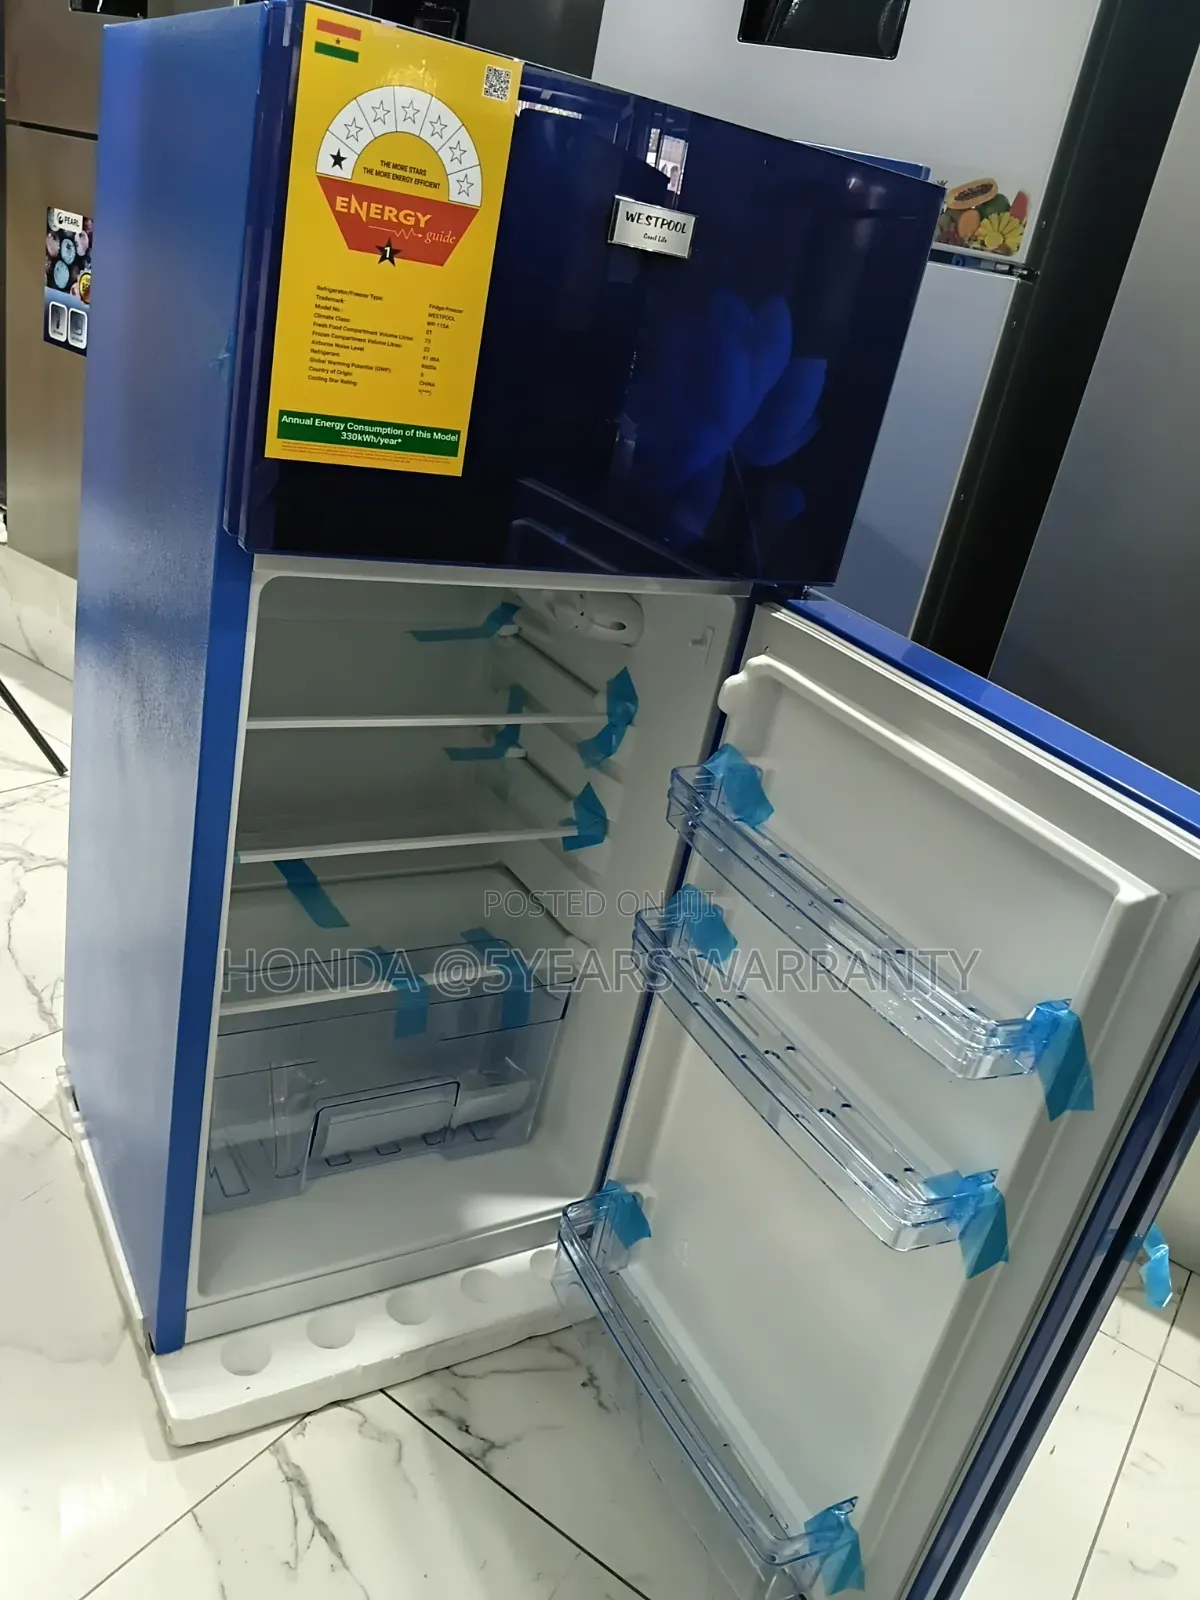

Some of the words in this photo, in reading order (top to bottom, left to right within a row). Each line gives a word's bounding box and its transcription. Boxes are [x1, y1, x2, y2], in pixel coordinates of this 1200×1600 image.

[380, 160, 391, 168] THE
[392, 163, 408, 172] MORE
[409, 166, 426, 176] STARS
[363, 167, 374, 175] THE
[375, 170, 391, 179] MORE
[392, 174, 413, 184] ENERGY
[414, 178, 440, 189] EFFICIENT
[335, 194, 432, 228] ENERGY
[64, 216, 79, 227] PEARL
[626, 211, 686, 234] WESTPOOL
[424, 230, 456, 244] guide
[643, 233, 657, 241] Good
[384, 247, 390, 258] 1
[316, 286, 369, 299] Refrigerator/Freezer
[316, 294, 345, 304] Trademark:
[429, 304, 464, 314] Fridge-Freezer
[428, 313, 455, 321] WESTPOOL
[343, 326, 378, 336] Compartment
[379, 331, 398, 339] Volume
[331, 333, 366, 344] Compartment
[368, 338, 386, 346] Volume
[309, 366, 330, 375] Country
[327, 360, 350, 369] Warming
[351, 362, 374, 371] Potential
[308, 375, 328, 383] Cooling
[281, 414, 313, 426] Annual
[315, 418, 345, 430] Energy
[347, 422, 403, 436] Consumption
[405, 429, 415, 437] of
[416, 429, 431, 439] this
[433, 431, 458, 442] Model
